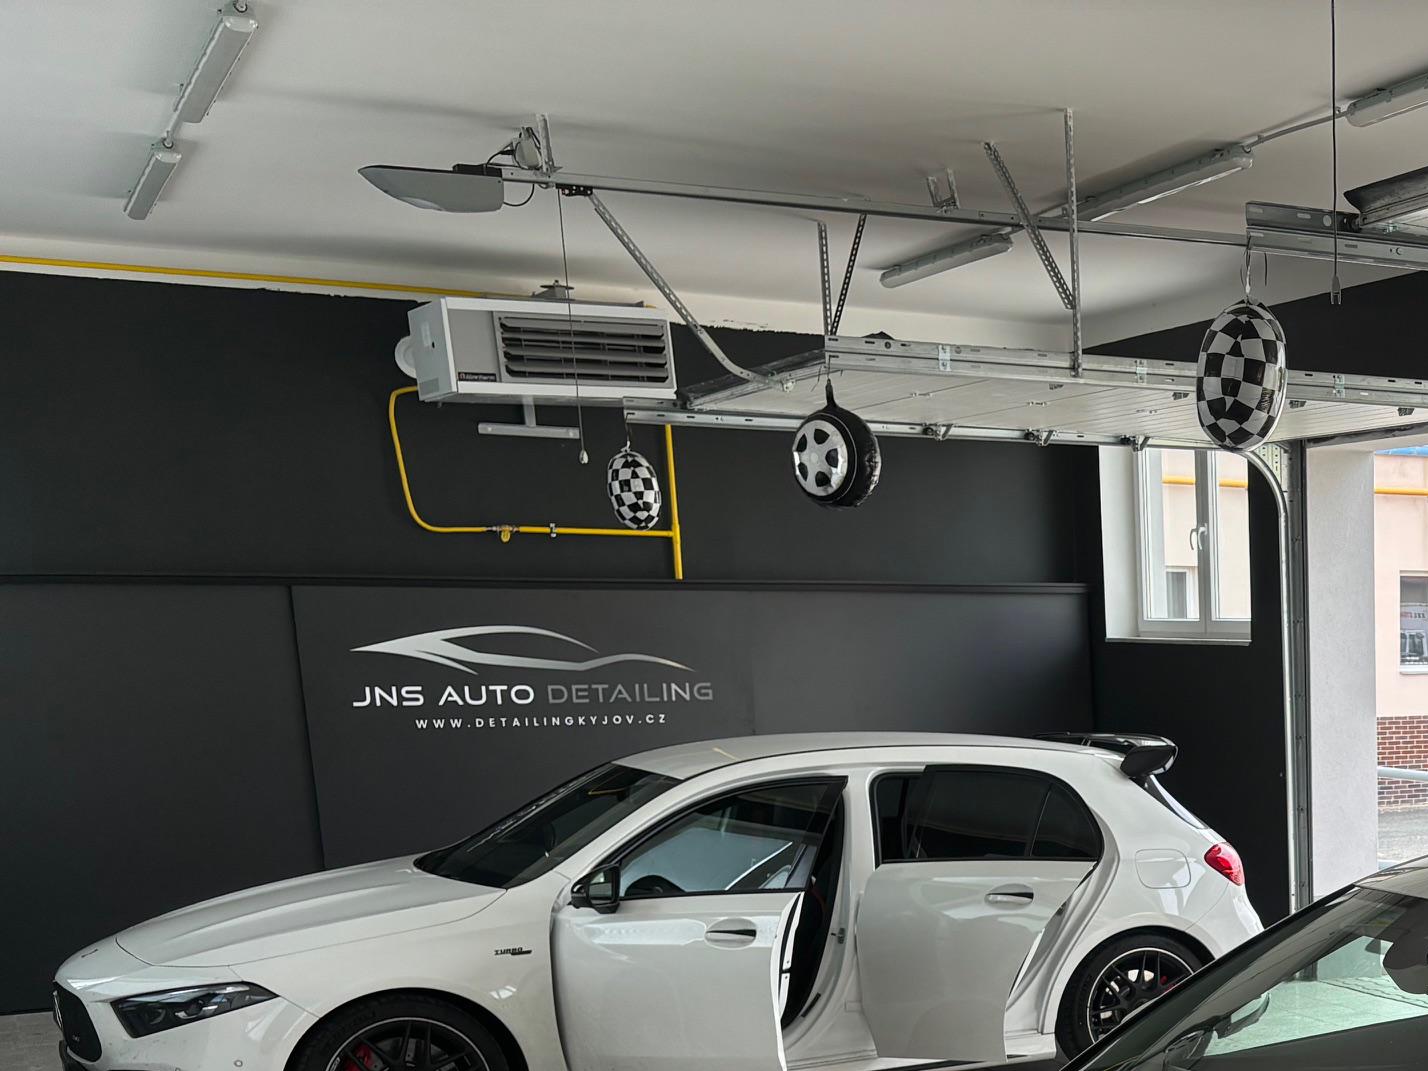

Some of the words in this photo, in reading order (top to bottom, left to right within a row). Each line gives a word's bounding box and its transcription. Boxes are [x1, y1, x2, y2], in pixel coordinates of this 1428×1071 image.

[352, 685, 425, 707] JNS
[438, 684, 535, 706] AUTO
[547, 681, 714, 704] DETAILING
[415, 713, 666, 729] WWW.DETAILINGKYJOV.CZ
